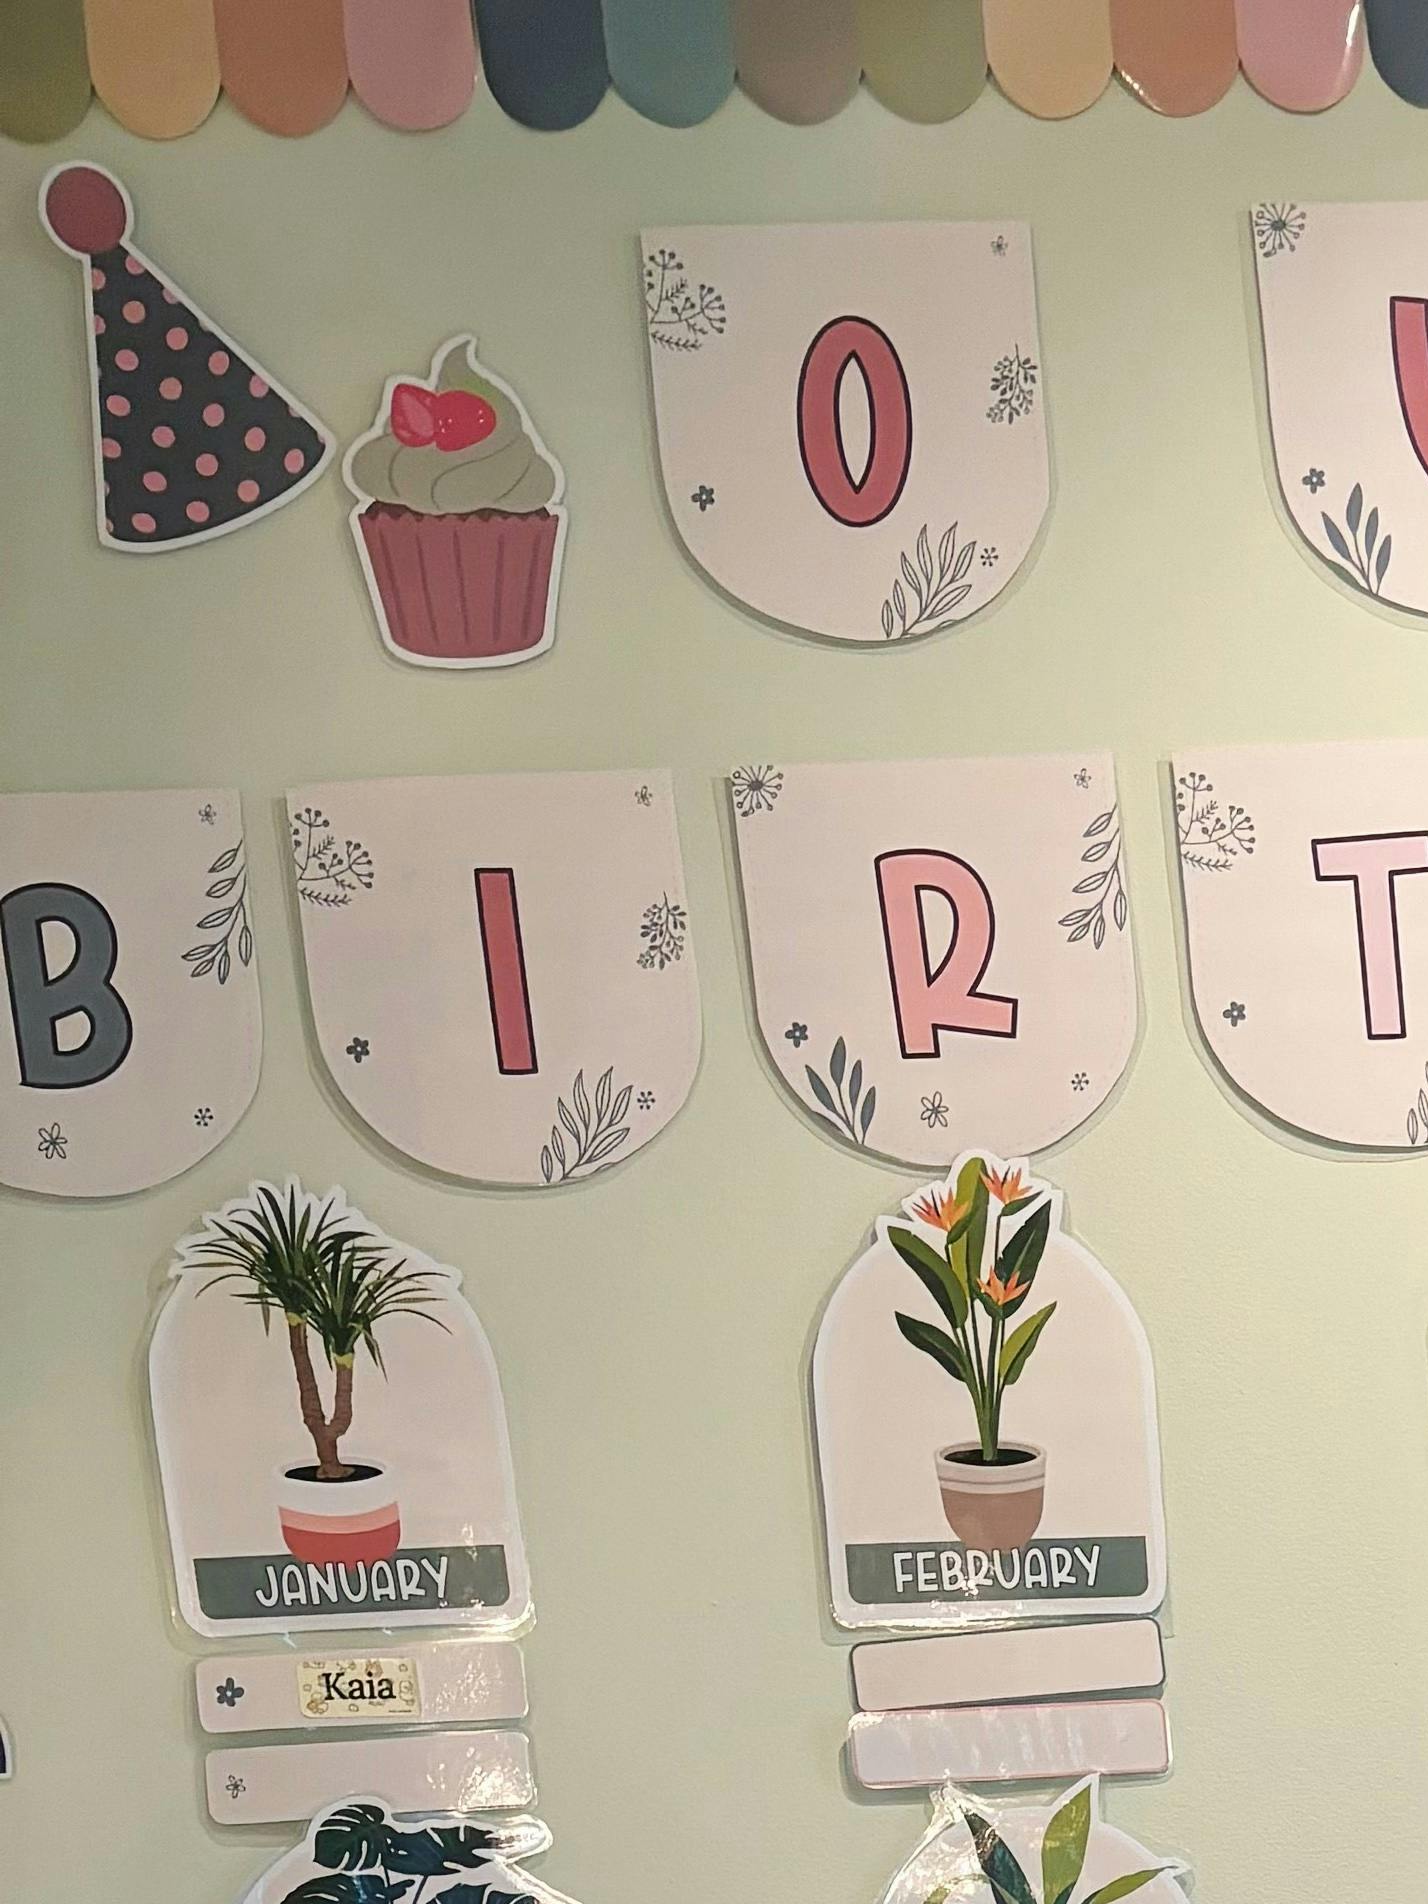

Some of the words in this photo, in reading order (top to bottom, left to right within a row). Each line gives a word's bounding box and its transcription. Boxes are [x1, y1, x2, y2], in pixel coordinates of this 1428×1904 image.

[256, 1557, 448, 1608] JANUARY
[893, 1545, 1101, 1593] FEBRUARY
[322, 1670, 397, 1701] Kaia
